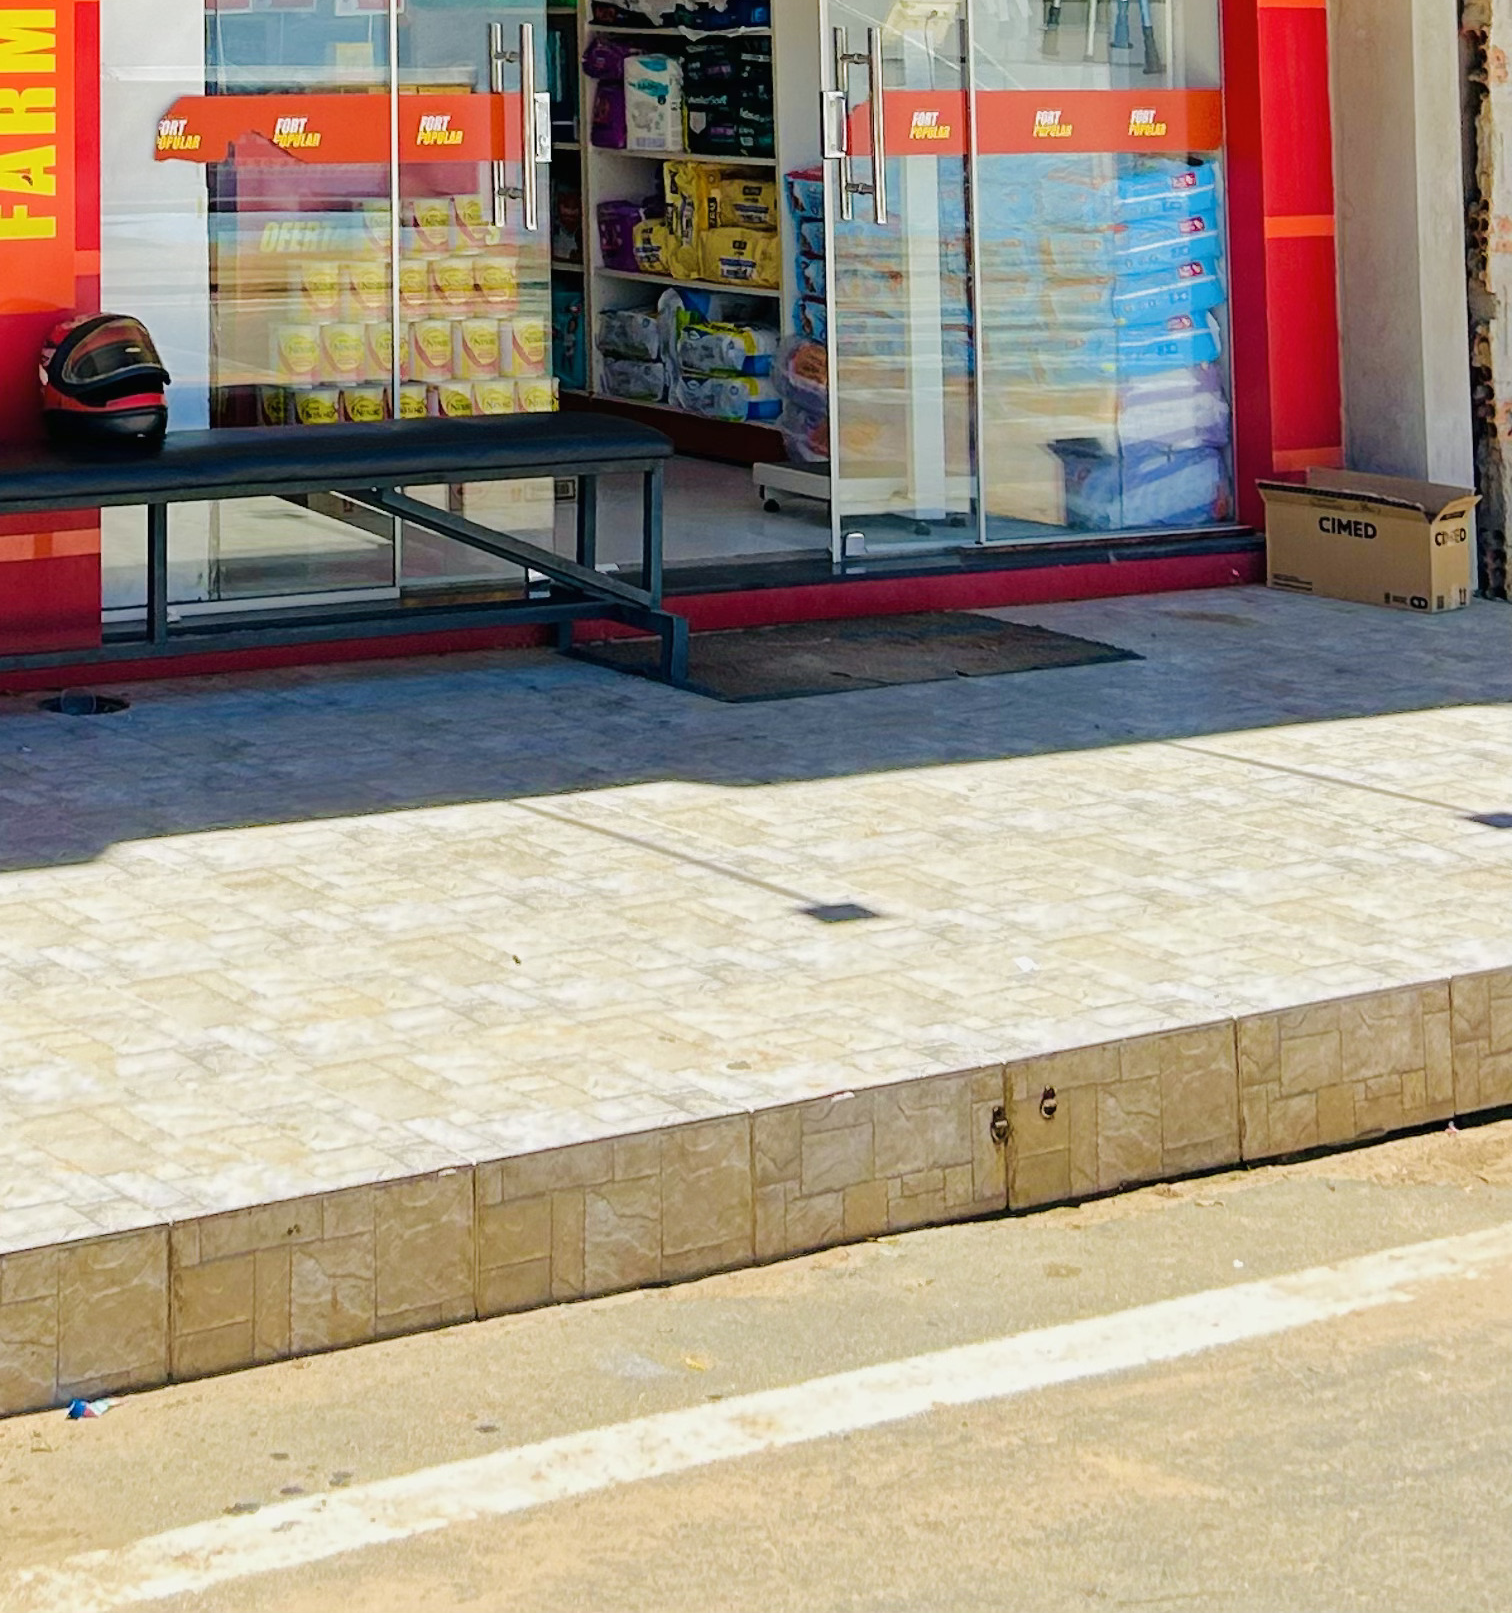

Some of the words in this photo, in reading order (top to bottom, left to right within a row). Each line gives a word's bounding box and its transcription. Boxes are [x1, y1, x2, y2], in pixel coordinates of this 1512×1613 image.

[419, 115, 451, 133] FORT
[911, 111, 940, 127] FORT
[1034, 110, 1062, 126] FORT
[1130, 109, 1156, 125] FORT
[275, 116, 309, 135] FORT
[158, 134, 202, 150] OPULAR
[417, 130, 463, 146] POPULAR
[1318, 516, 1377, 540] CIMED
